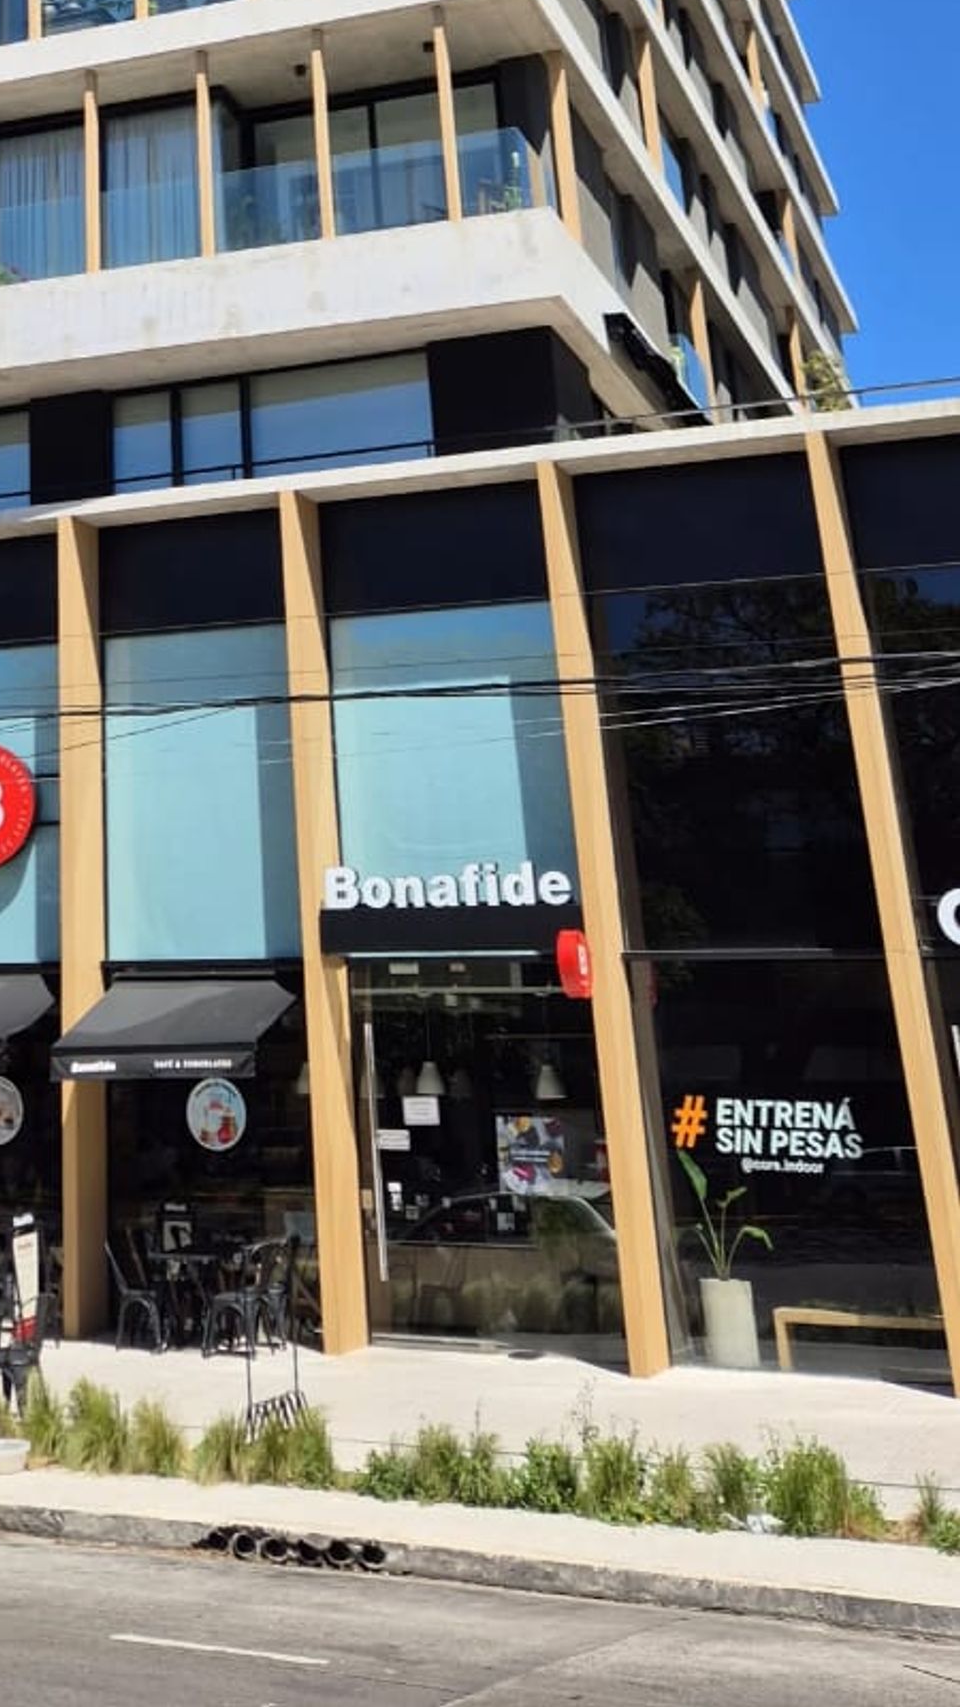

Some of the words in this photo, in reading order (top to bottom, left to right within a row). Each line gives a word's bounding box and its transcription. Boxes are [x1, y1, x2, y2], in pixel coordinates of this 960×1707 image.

[324, 861, 571, 909] Bonafide
[716, 1097, 855, 1131] ENTRENÁ
[716, 1128, 763, 1155] SIN
[770, 1130, 863, 1159] PESAS
